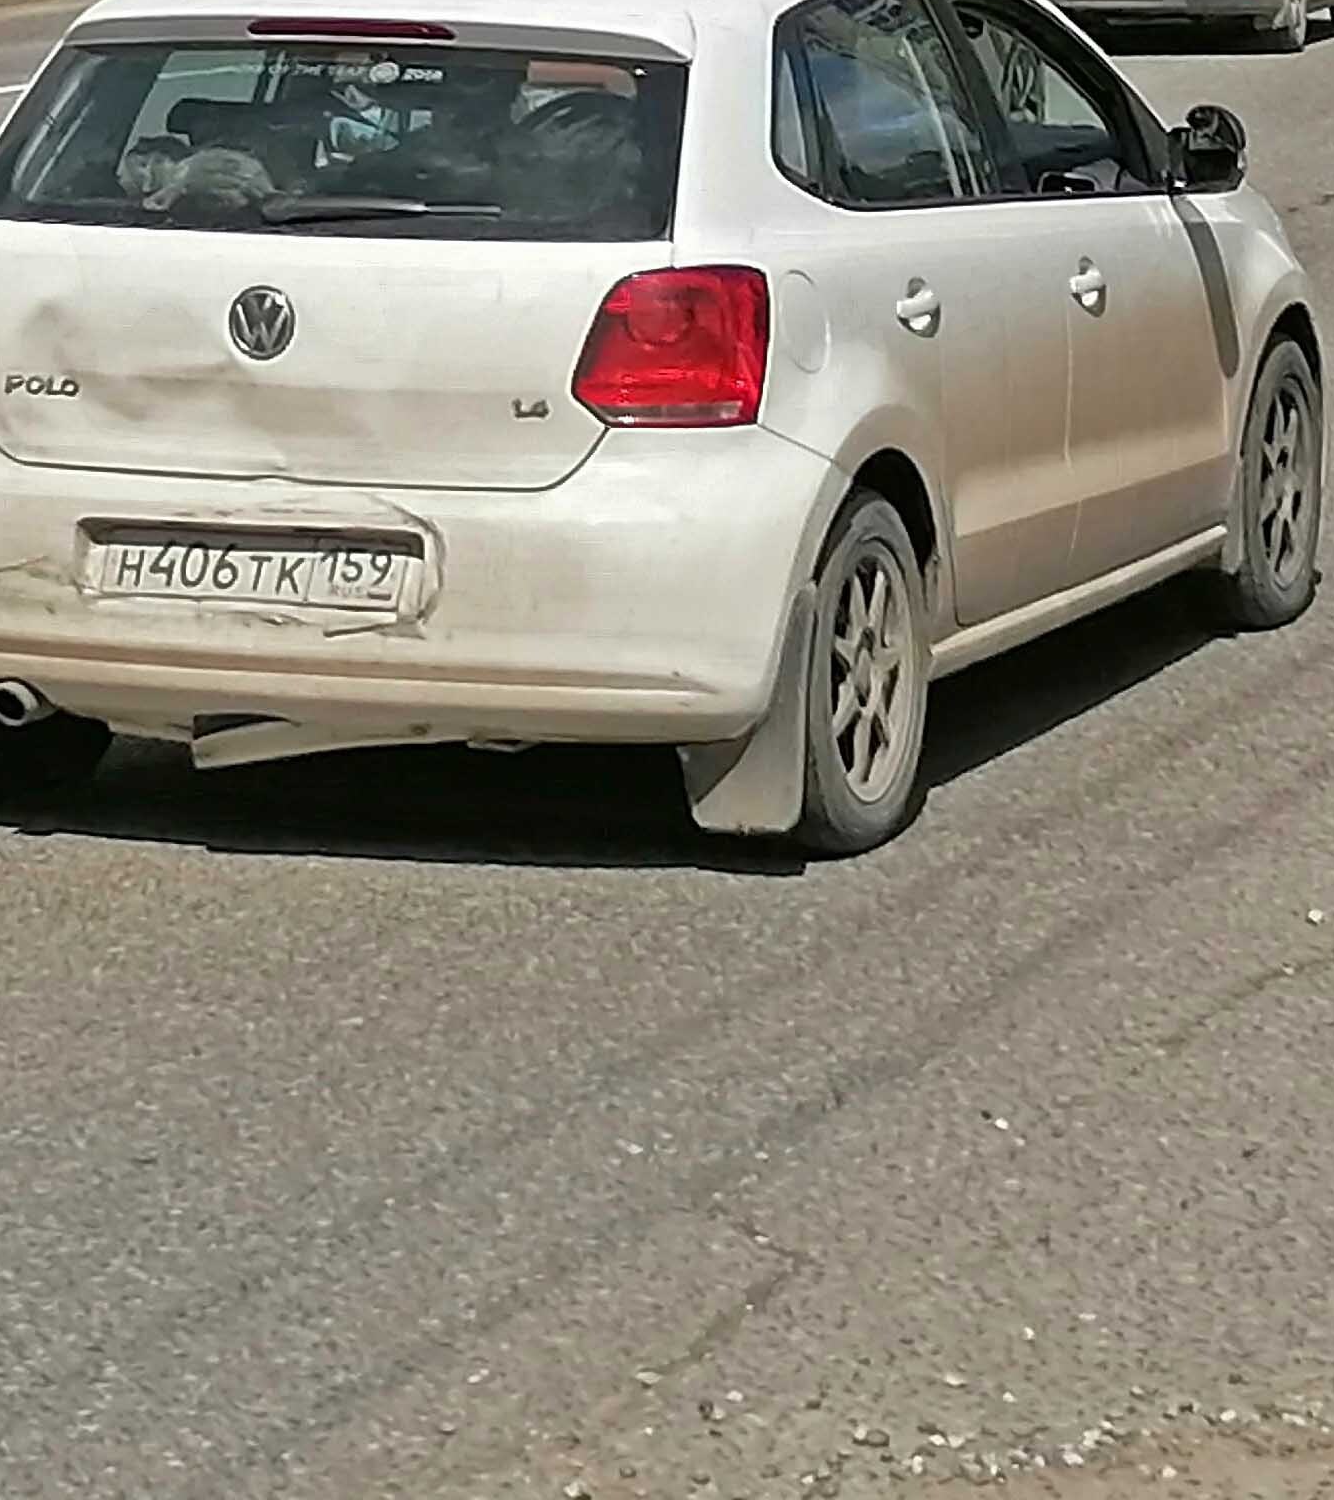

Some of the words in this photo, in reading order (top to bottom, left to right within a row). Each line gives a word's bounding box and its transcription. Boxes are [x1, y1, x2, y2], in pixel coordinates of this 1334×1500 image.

[4, 374, 80, 398] POLO
[117, 541, 305, 596] Н406ТК
[321, 547, 392, 588] 159
